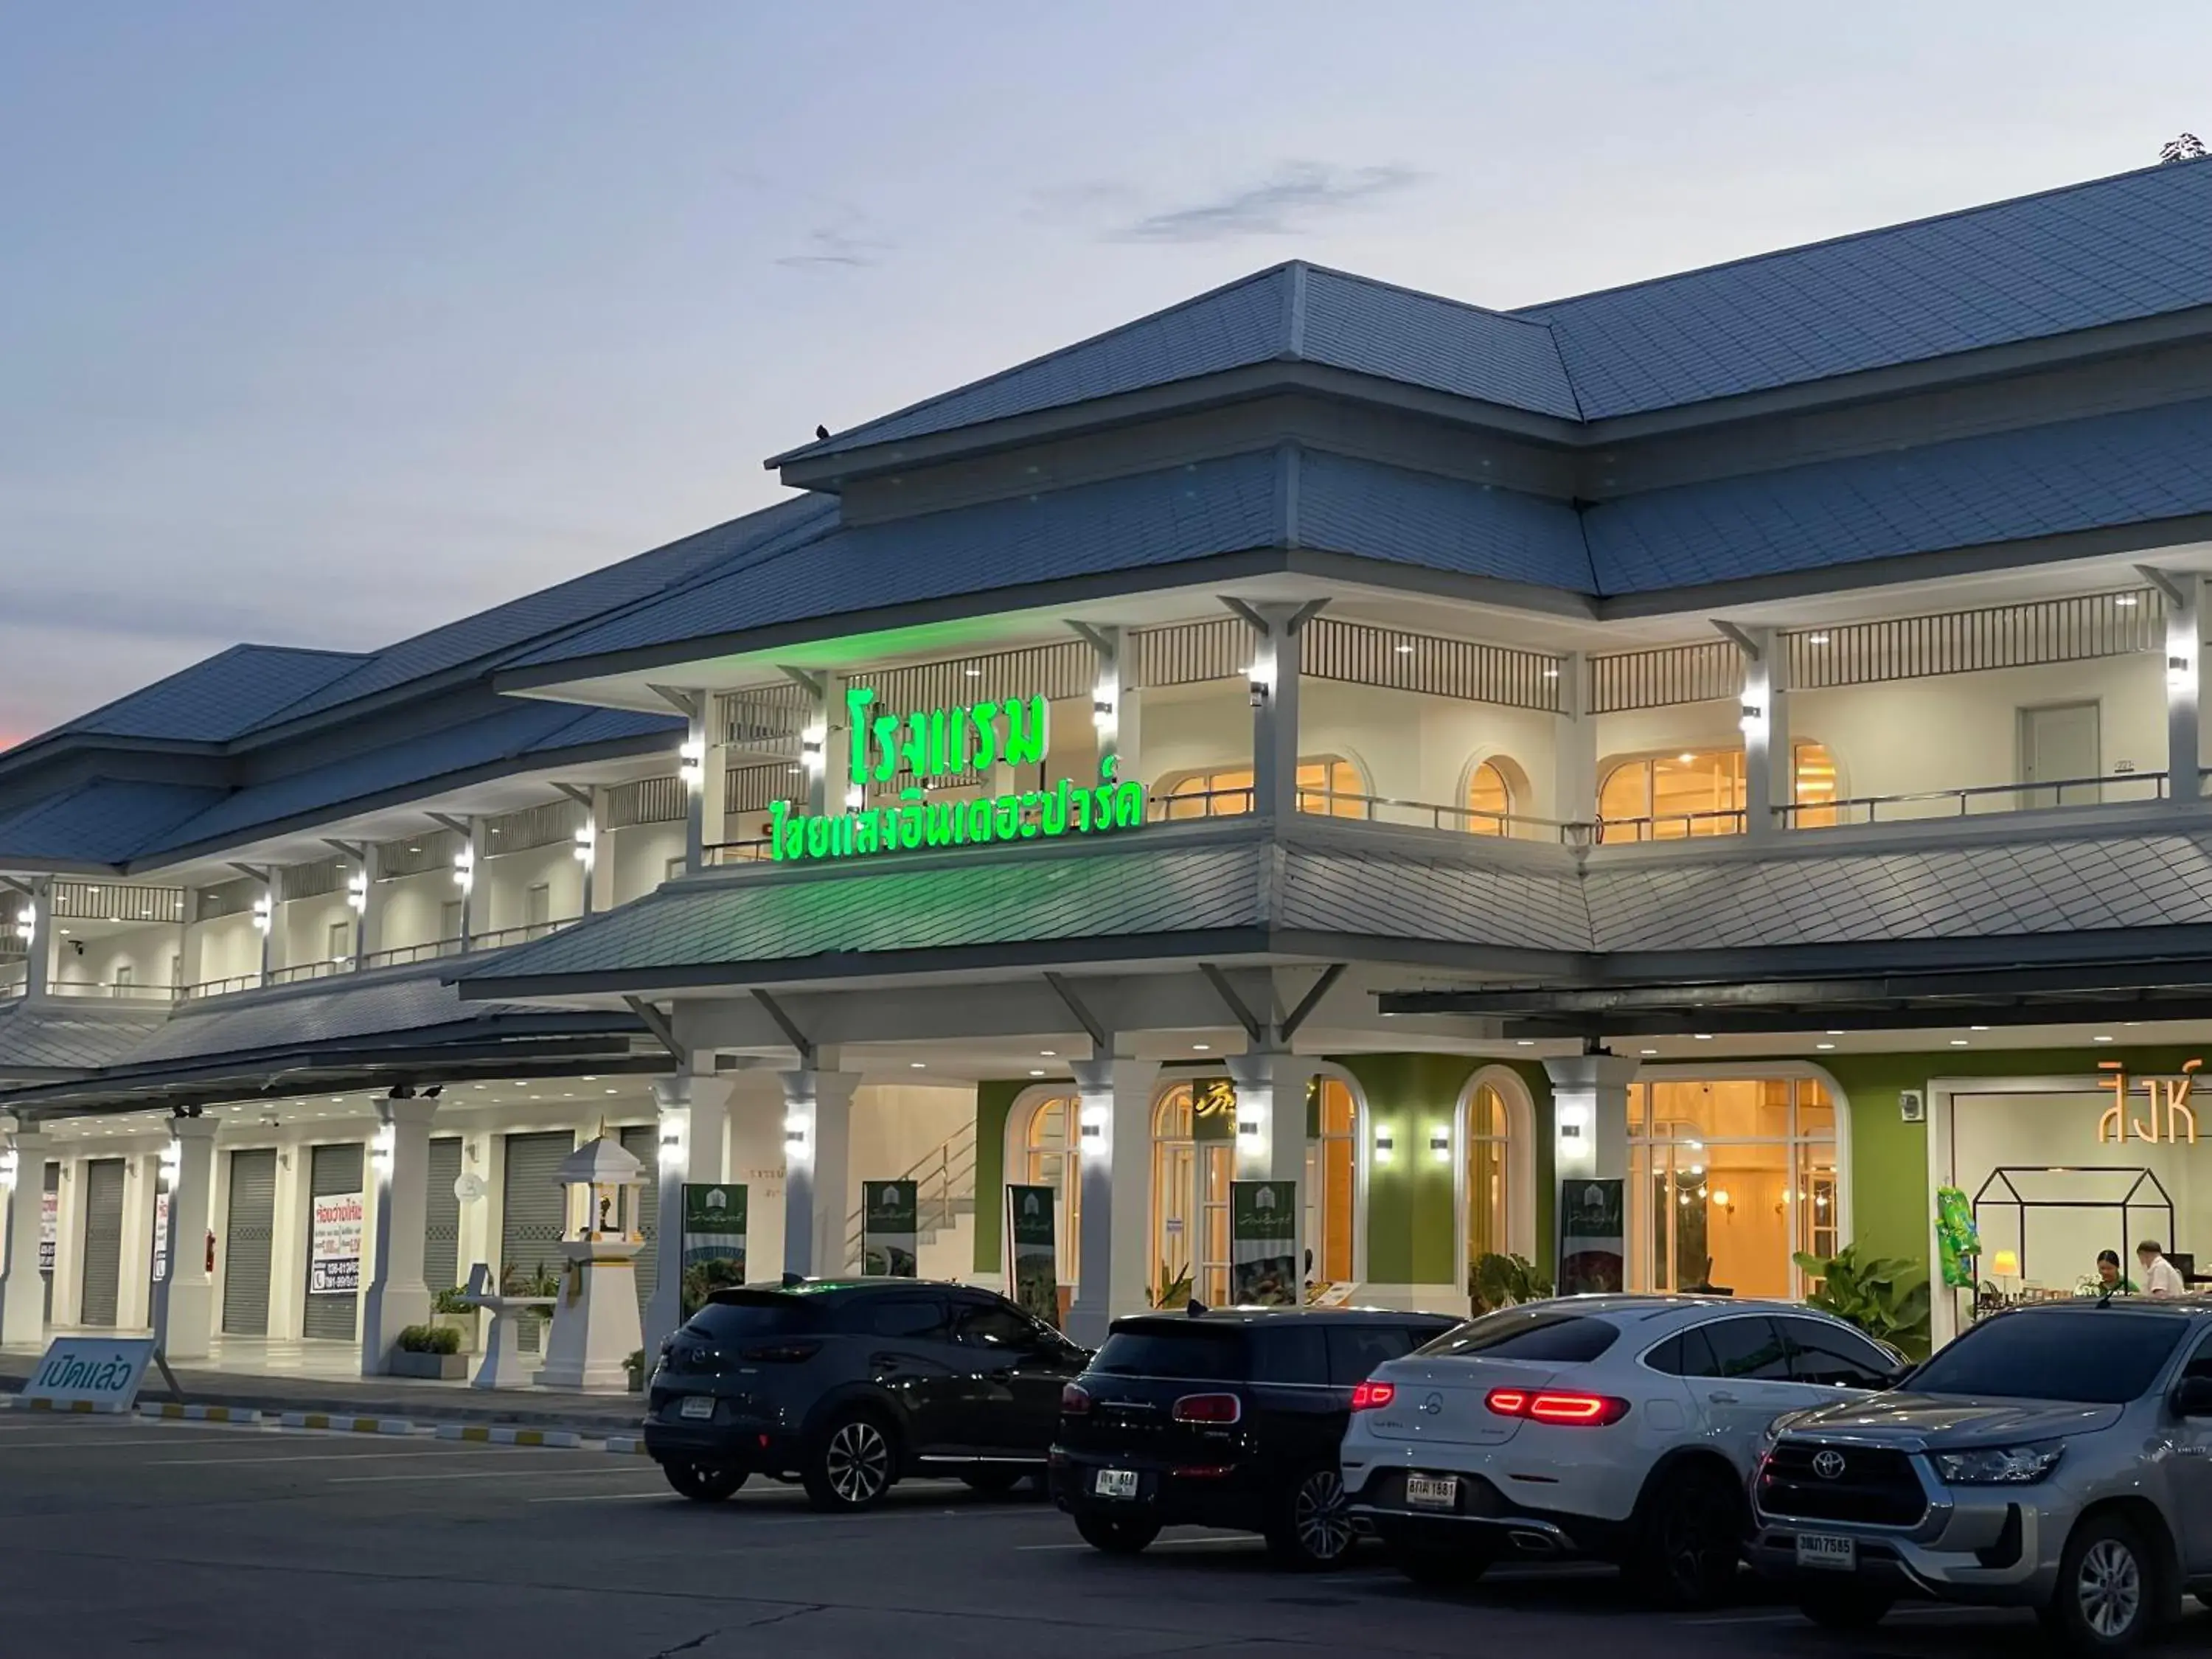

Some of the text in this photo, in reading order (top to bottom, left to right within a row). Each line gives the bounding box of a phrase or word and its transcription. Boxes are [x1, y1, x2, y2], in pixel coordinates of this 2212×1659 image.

[846, 687, 1050, 785] โรงแรม
[38, 1354, 133, 1391] เปิดแล้ว
